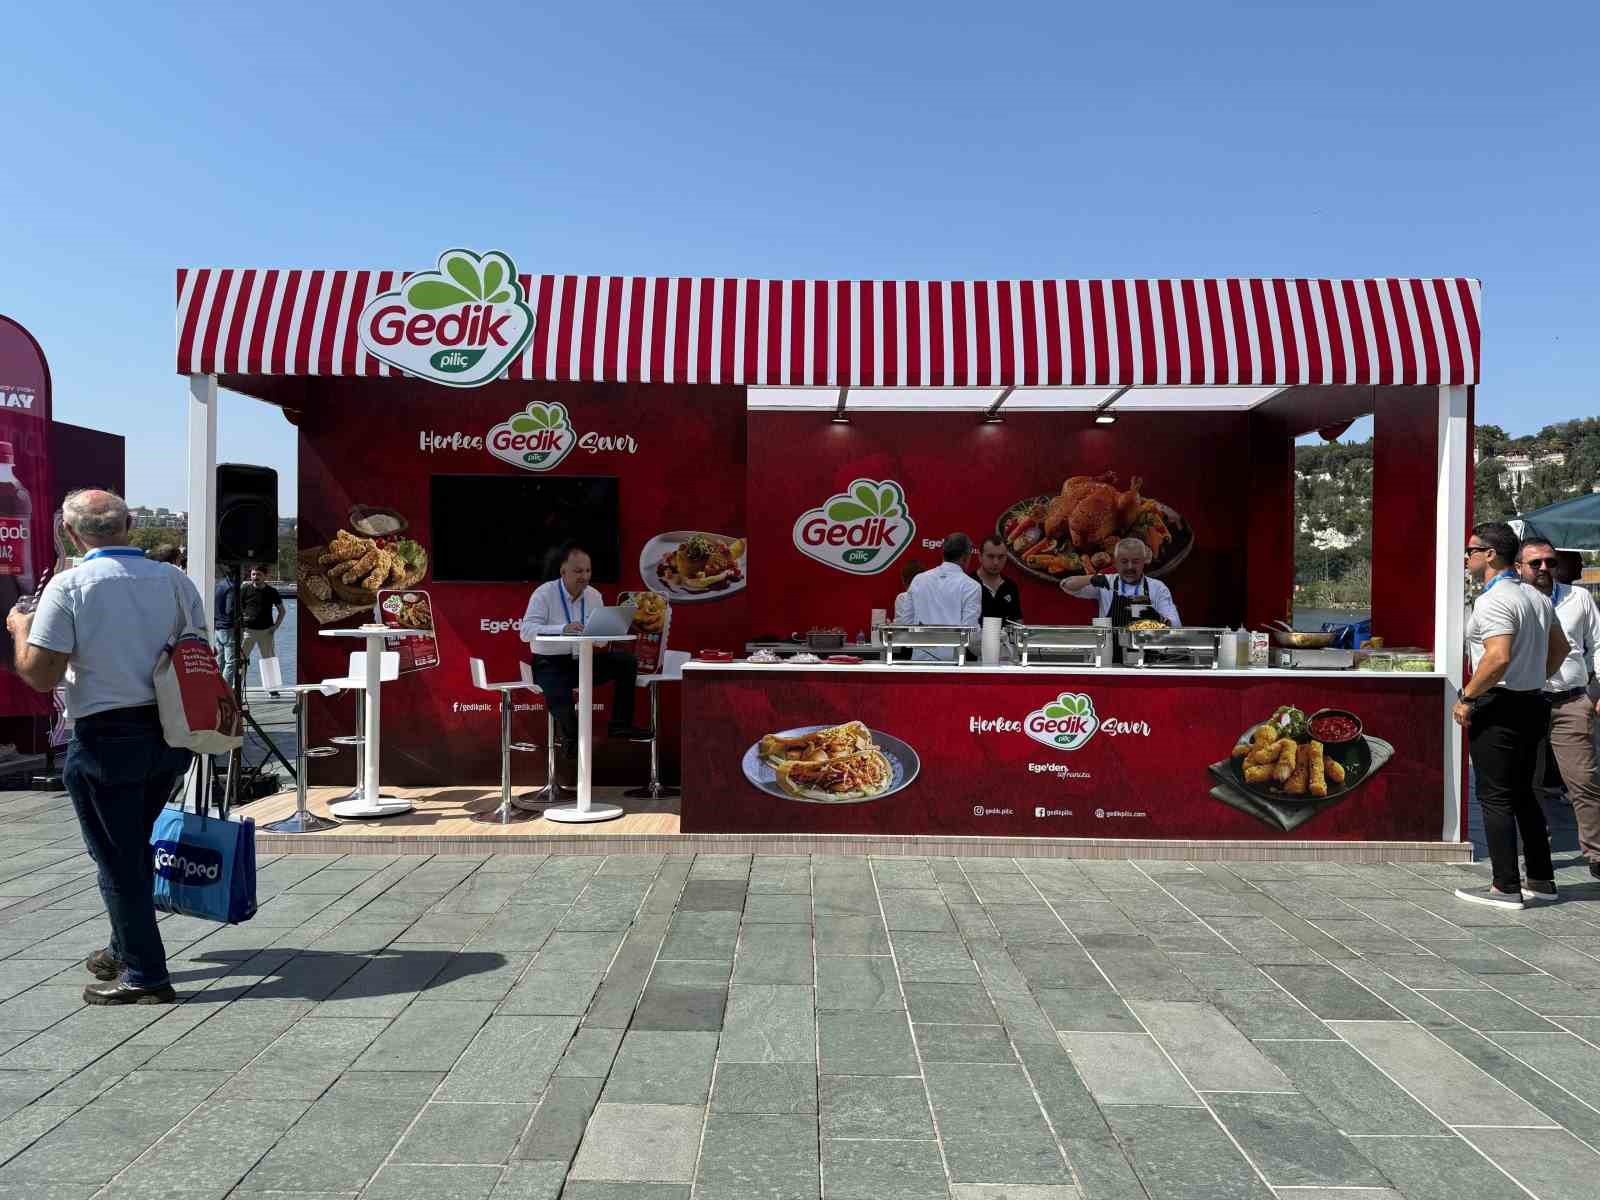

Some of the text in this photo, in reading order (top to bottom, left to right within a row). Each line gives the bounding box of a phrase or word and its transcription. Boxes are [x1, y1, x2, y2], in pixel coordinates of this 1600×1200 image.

[370, 304, 512, 347] Gedik
[440, 352, 469, 368] piliç
[419, 430, 638, 454] Herkes Gedik Sever
[802, 518, 899, 547] Gedik
[922, 538, 945, 550] Ege'
[849, 551, 869, 561] piliç
[480, 618, 522, 634] Ege'd
[969, 715, 1151, 737] Herkes Gedik Sever
[1028, 763, 1069, 774] Ege'den
